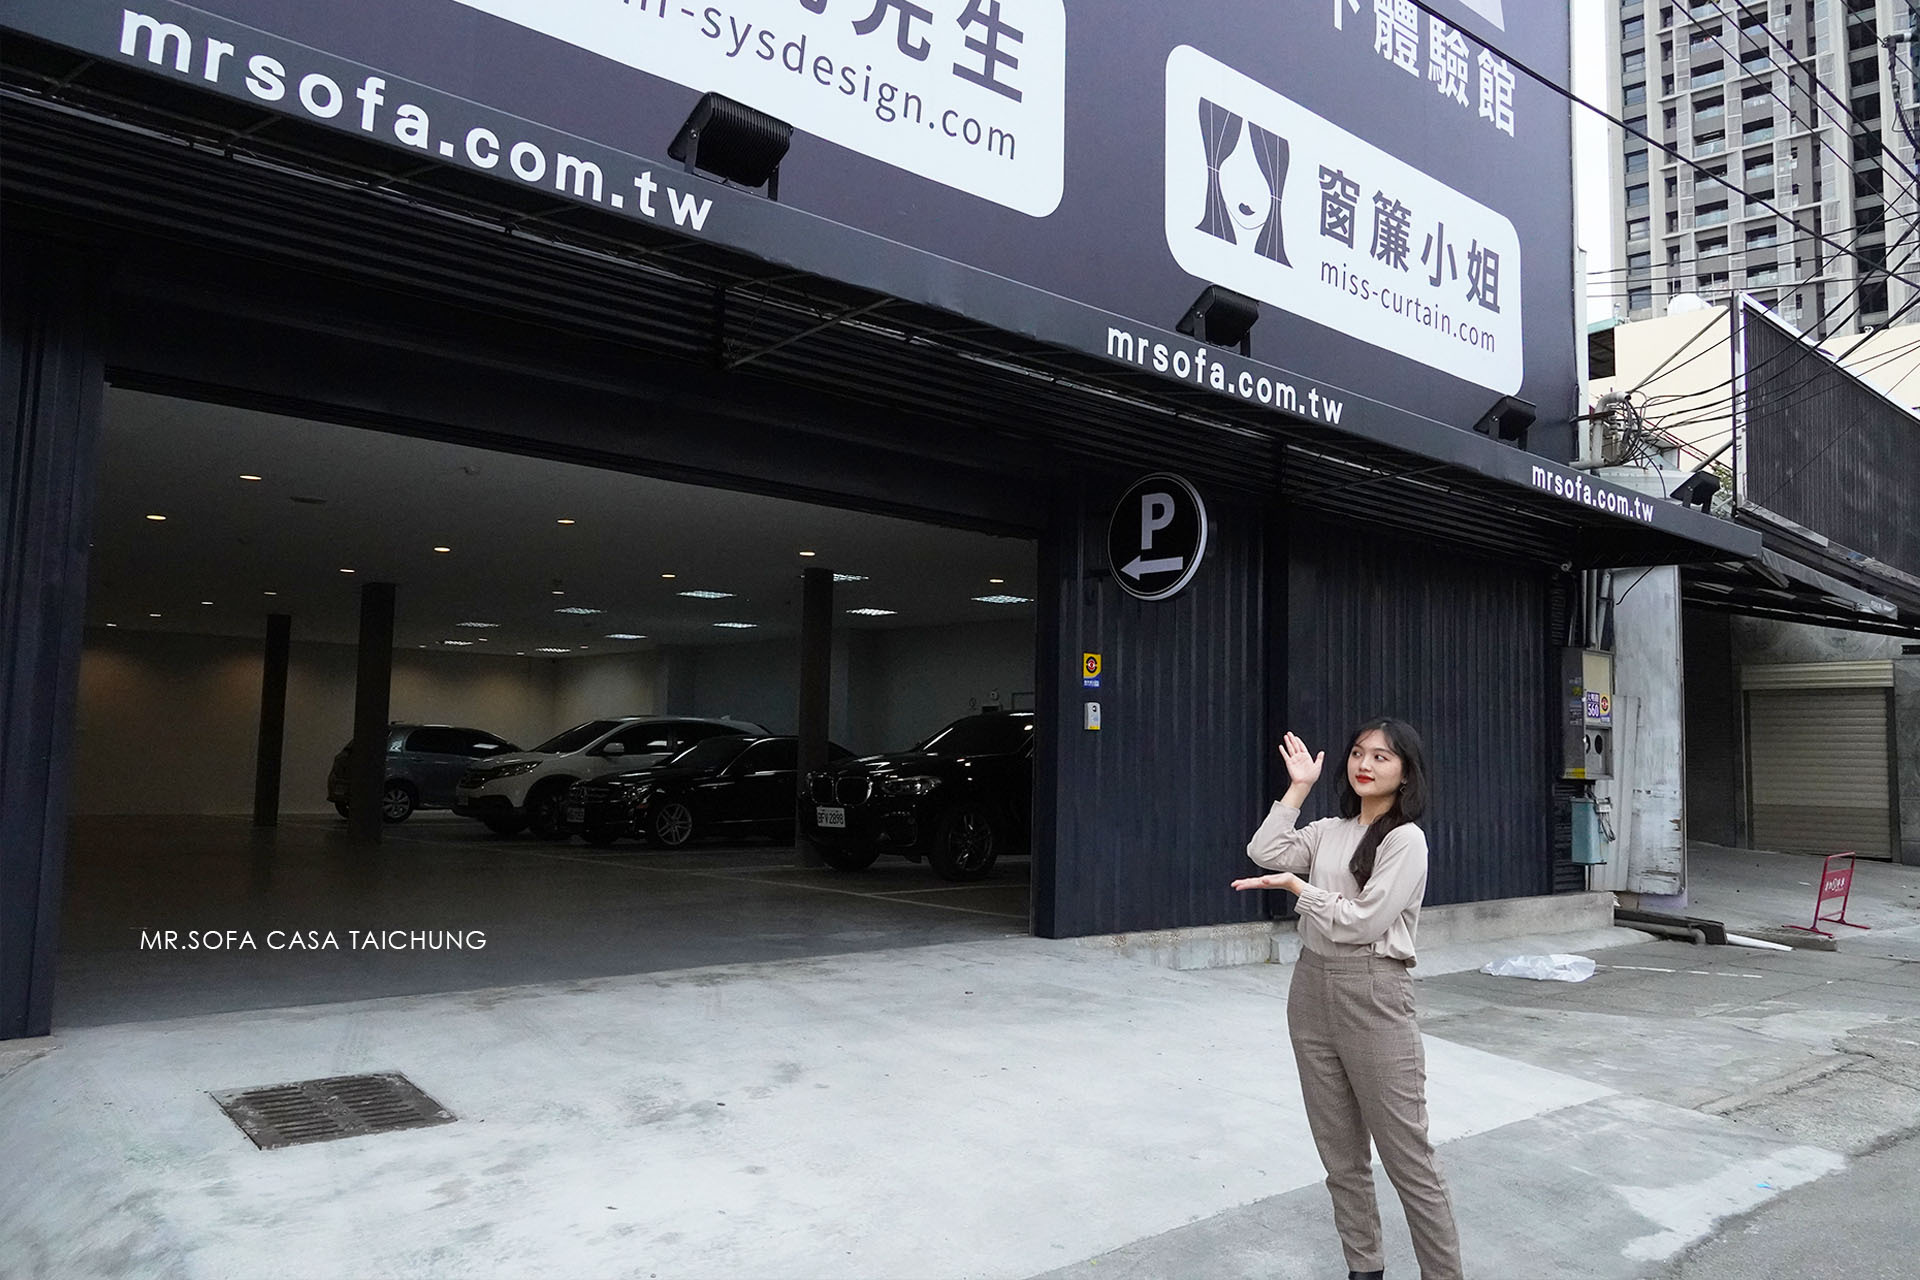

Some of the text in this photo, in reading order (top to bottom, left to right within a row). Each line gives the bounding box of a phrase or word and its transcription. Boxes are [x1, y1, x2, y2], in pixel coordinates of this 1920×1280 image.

[120, 8, 713, 231] mrsofa.com.tw
[1319, 164, 1500, 314] 窗簾小姐
[1321, 259, 1496, 352] miss-curtain.com
[1106, 324, 1344, 425] mrsofa.com.tw
[1141, 492, 1176, 550] P
[1532, 464, 1654, 523] mrsofa.com.tw
